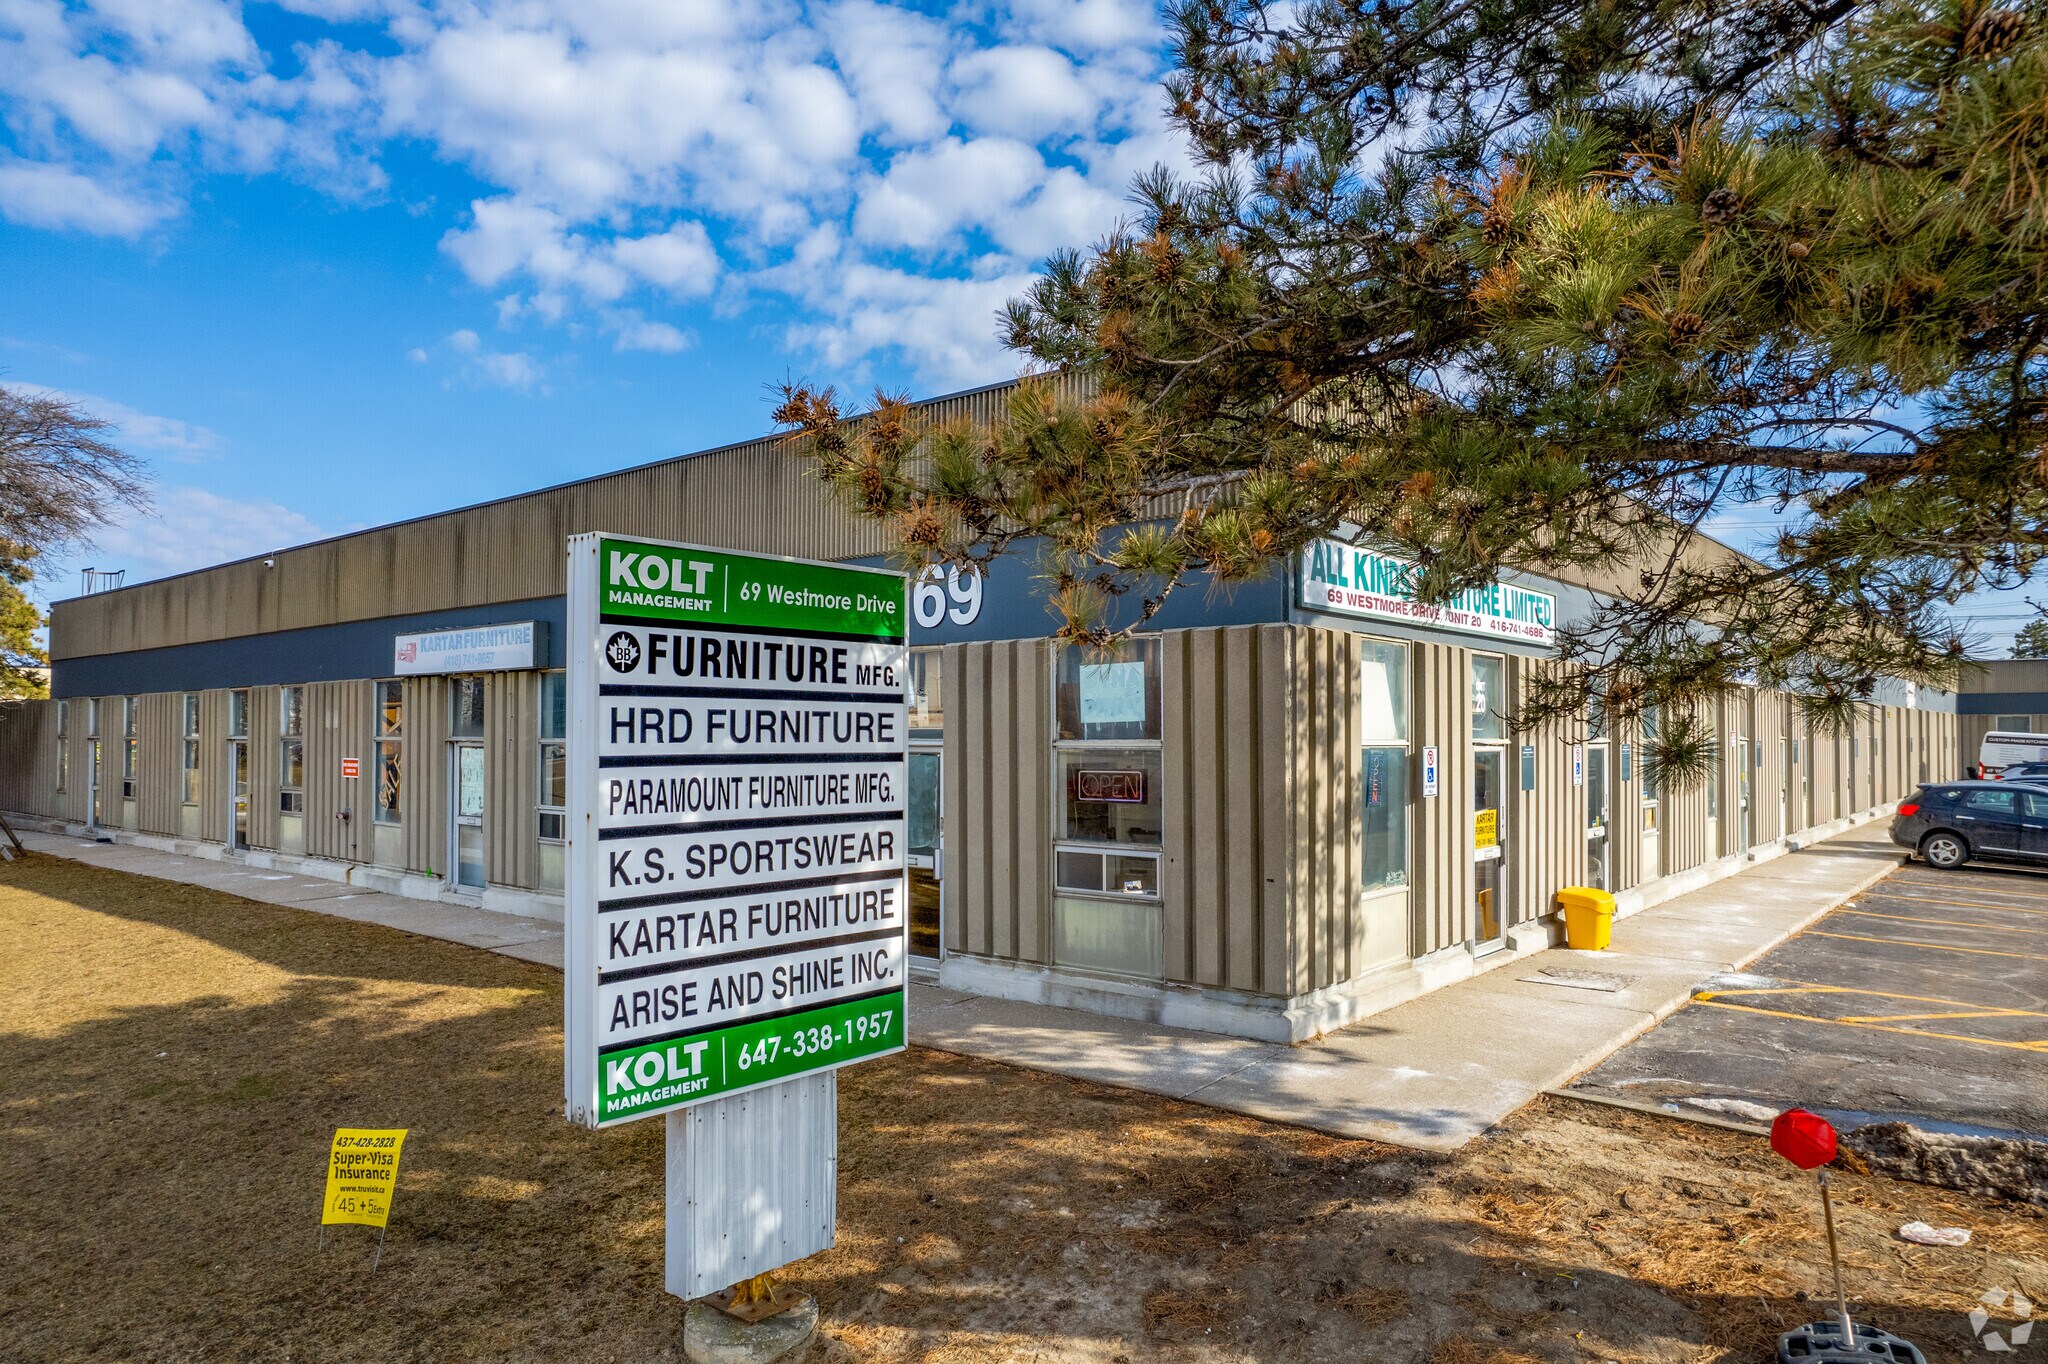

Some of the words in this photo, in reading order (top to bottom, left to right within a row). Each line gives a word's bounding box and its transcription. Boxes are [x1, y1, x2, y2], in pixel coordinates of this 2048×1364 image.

[609, 550, 714, 595] KOLT
[1310, 540, 1348, 588] ALL
[1354, 551, 1410, 601] KINDS
[1503, 586, 1552, 627] LIMITED
[609, 589, 712, 612] MANAGEMENT
[739, 581, 761, 602] 69
[767, 584, 852, 611] Westmore
[856, 593, 896, 614] Drive
[913, 562, 983, 628] 69
[1327, 588, 1343, 604] 69
[1346, 592, 1408, 616] WESTMORE
[1411, 603, 1440, 621] DRIVE
[1447, 610, 1469, 625] UNIT
[1471, 615, 1482, 627] 20
[420, 633, 463, 653] KARTAR
[464, 626, 531, 649] FURNITURE
[616, 647, 631, 661] BB
[647, 633, 848, 685] FURNITURE
[856, 664, 900, 687] MFG.
[610, 706, 693, 744] HRD
[706, 709, 895, 744] FURNITURE
[609, 776, 743, 816] PARAMOUNT
[748, 773, 850, 809] FURNITURE
[855, 771, 895, 804] MFG.
[1082, 775, 1139, 799] OPEN
[1372, 757, 1380, 803] OPEN
[1475, 824, 1495, 836] FURNITURE
[1476, 812, 1495, 825] KARTAR
[609, 846, 675, 888] K.S.
[686, 830, 894, 879] SPORTSWEAR
[609, 907, 738, 960] KARTAR
[748, 887, 895, 940] FURNITURE
[609, 981, 698, 1032] ARISE
[706, 970, 765, 1013] AND
[772, 956, 844, 1000] SHINE
[851, 948, 895, 984] INC.
[737, 1009, 894, 1071] 647-338-1957
[606, 1040, 709, 1096] KOLT
[606, 1078, 710, 1113] MANAGEMENT
[333, 1151, 394, 1168] Super-Visa
[336, 1137, 396, 1148] 437-428-2828
[335, 1166, 391, 1180] Insurance
[338, 1198, 355, 1213] 45
